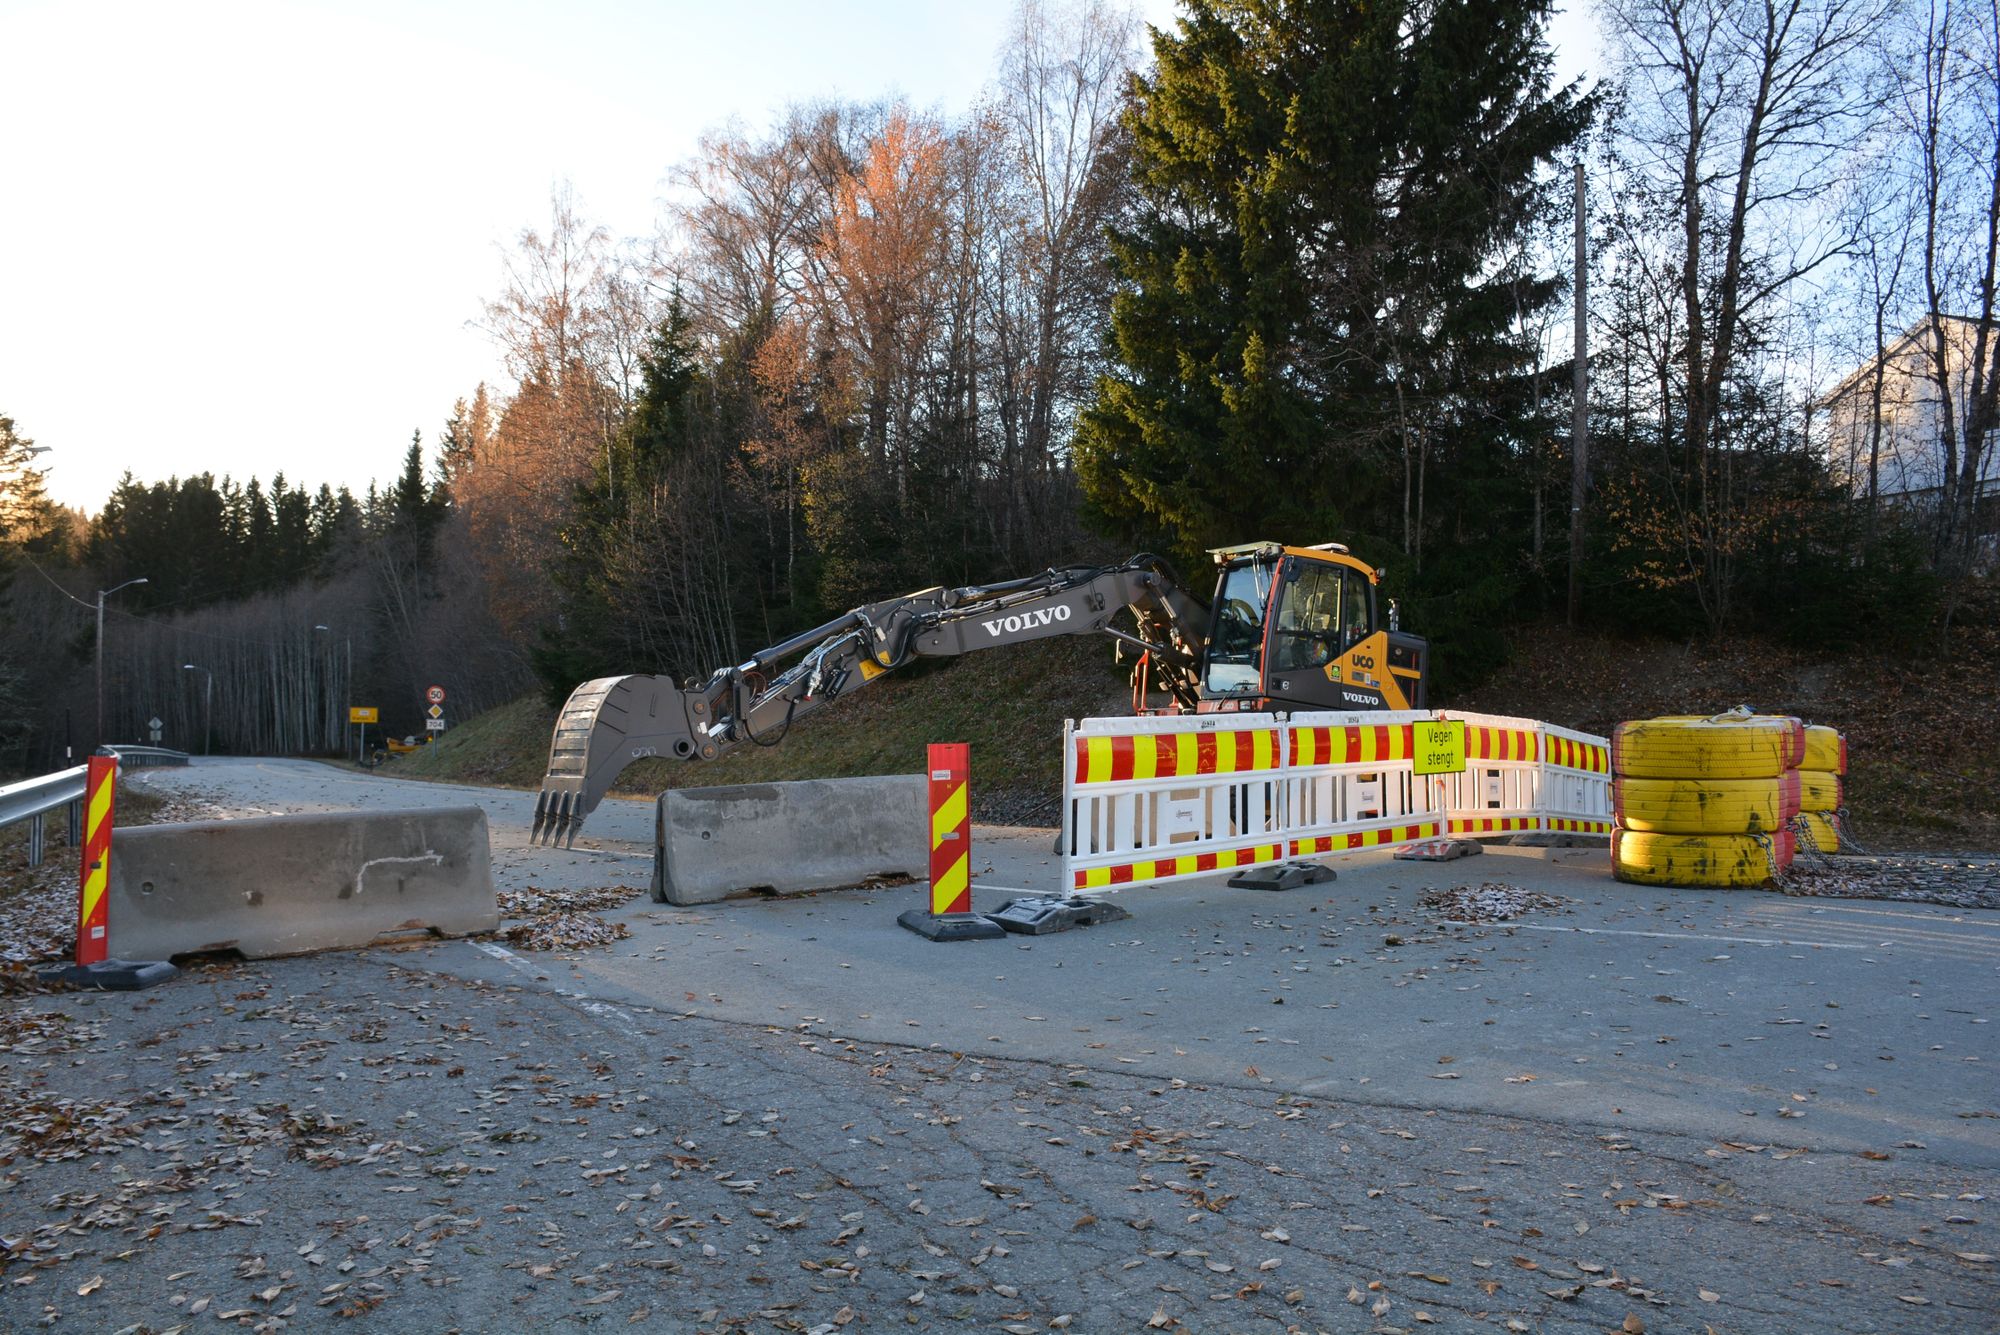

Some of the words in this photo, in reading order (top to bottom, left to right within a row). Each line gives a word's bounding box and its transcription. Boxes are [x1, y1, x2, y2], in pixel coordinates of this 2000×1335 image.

[981, 604, 1071, 637] VOLVO
[1352, 654, 1374, 669] UCO
[431, 690, 442, 699] 50
[1342, 691, 1379, 706] VOLVO
[1427, 728, 1454, 747] Vegen
[1427, 751, 1455, 768] stengt
